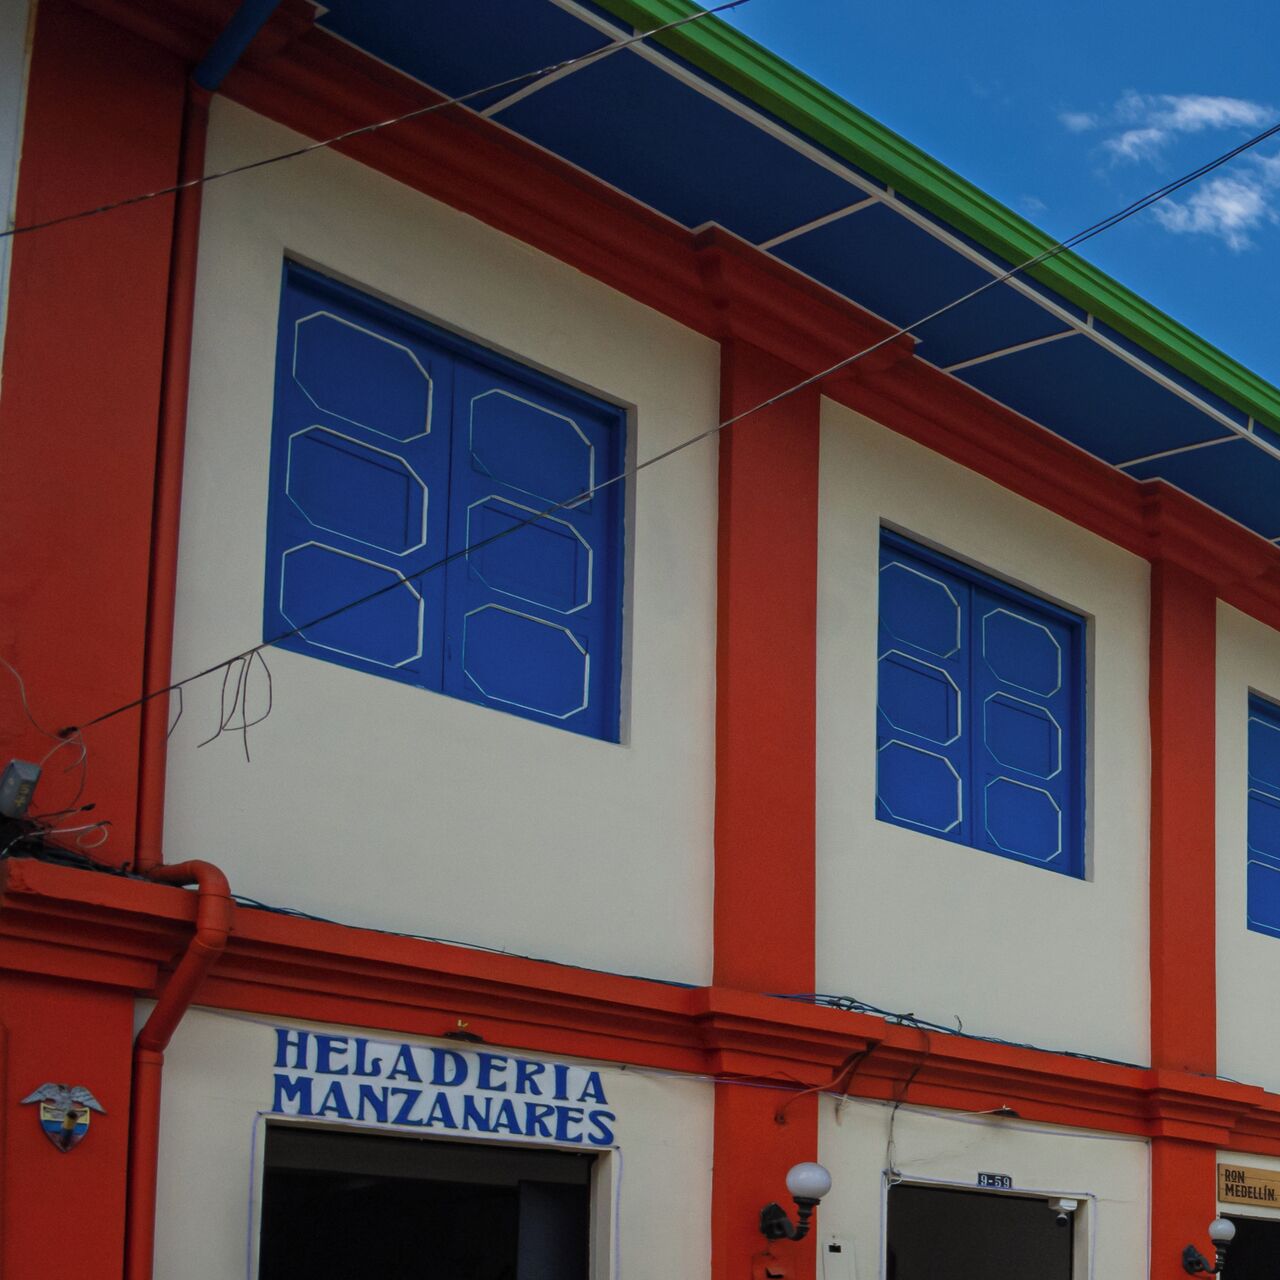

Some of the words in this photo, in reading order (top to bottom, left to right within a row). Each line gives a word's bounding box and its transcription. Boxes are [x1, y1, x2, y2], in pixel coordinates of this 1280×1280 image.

[273, 1027, 609, 1106] HELADERIA
[271, 1072, 617, 1146] MANZANARES
[980, 1174, 1010, 1189] 9-59
[1224, 1168, 1245, 1184] RON
